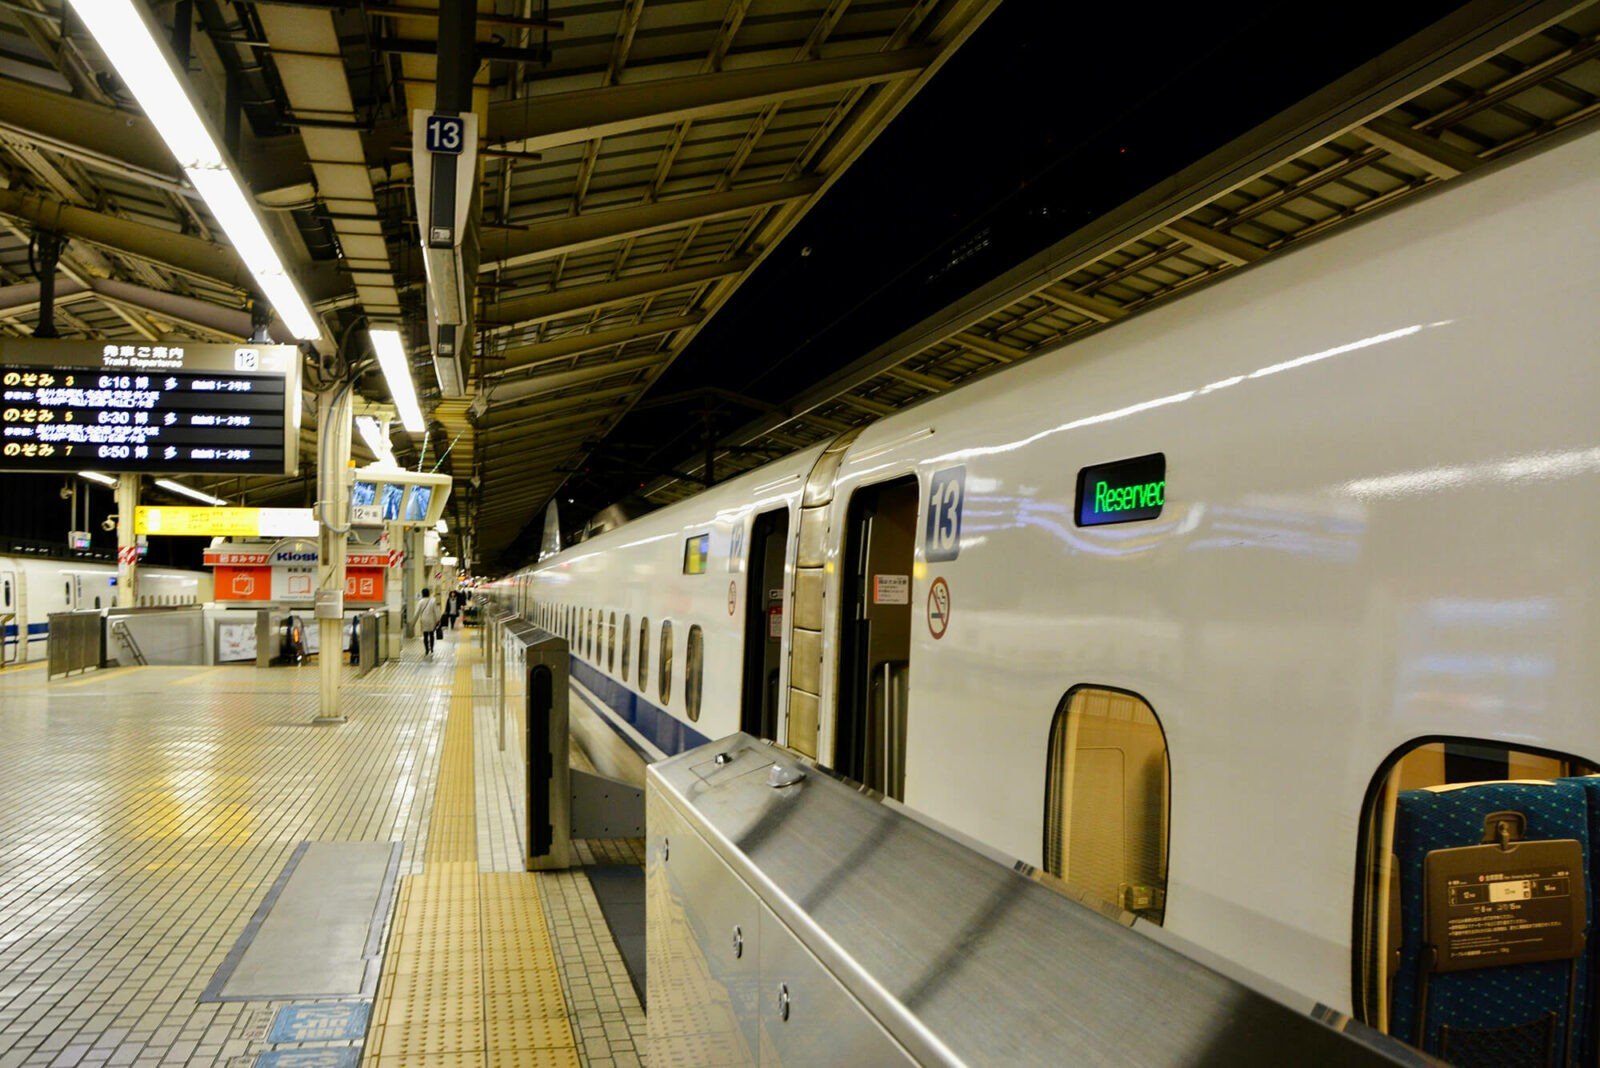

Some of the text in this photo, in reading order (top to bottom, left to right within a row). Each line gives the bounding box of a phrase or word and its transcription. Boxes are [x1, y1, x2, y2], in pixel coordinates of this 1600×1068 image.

[429, 121, 459, 149] 13
[103, 357, 183, 369] Train Departures
[3, 372, 55, 387] のぞみ
[3, 408, 54, 422] のぞみ
[4, 442, 55, 457] のぞみ
[65, 445, 73, 456] 7
[931, 479, 959, 550] 13
